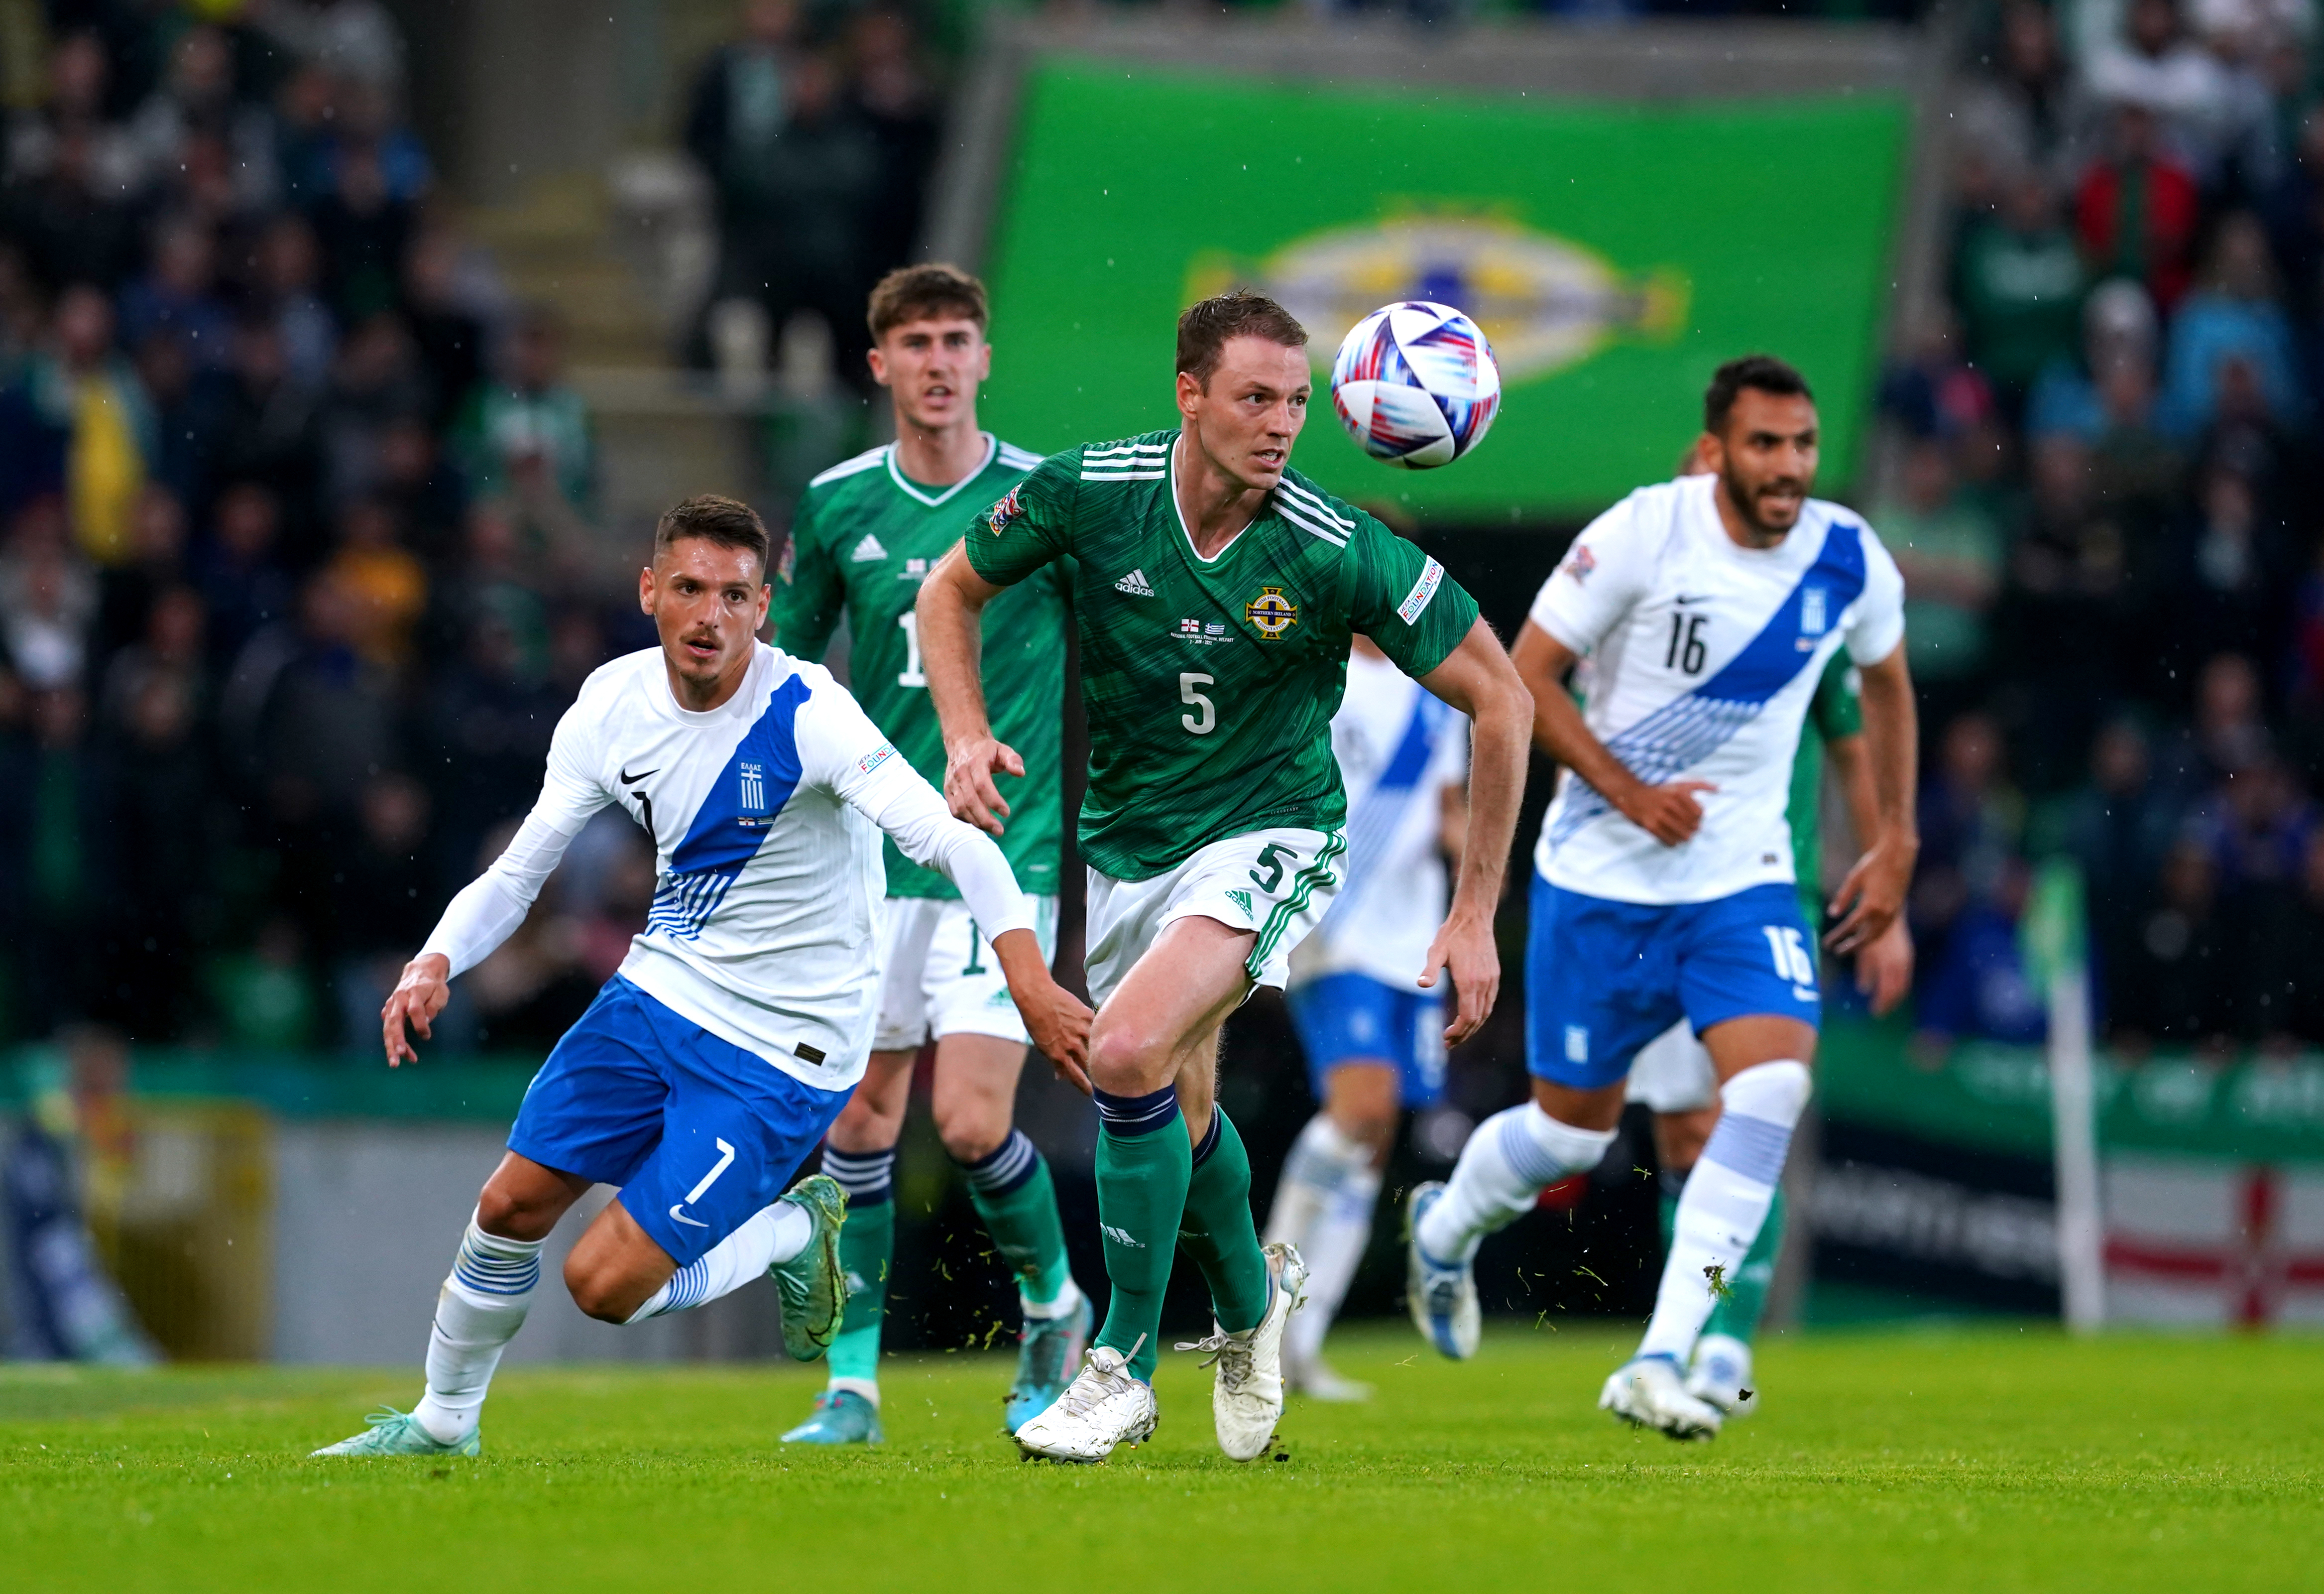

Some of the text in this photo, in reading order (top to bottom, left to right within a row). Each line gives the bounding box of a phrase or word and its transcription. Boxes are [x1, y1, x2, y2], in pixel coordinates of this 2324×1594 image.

[1115, 583, 1155, 597] adidas
[1268, 596, 1287, 609] FOOTBALL
[1403, 561, 1438, 619] FOUNDATION
[1399, 600, 1410, 613] UEFA
[1257, 620, 1286, 630] ASSOCIATION
[1666, 613, 1707, 674] 16
[1179, 673, 1215, 734] 5
[741, 762, 761, 771] ΕΛΛΑΣ
[858, 754, 870, 765] UEFA
[1249, 844, 1298, 893] 5
[1225, 891, 1254, 922] adidas
[1761, 925, 1813, 986] 16
[685, 1137, 734, 1205] 7
